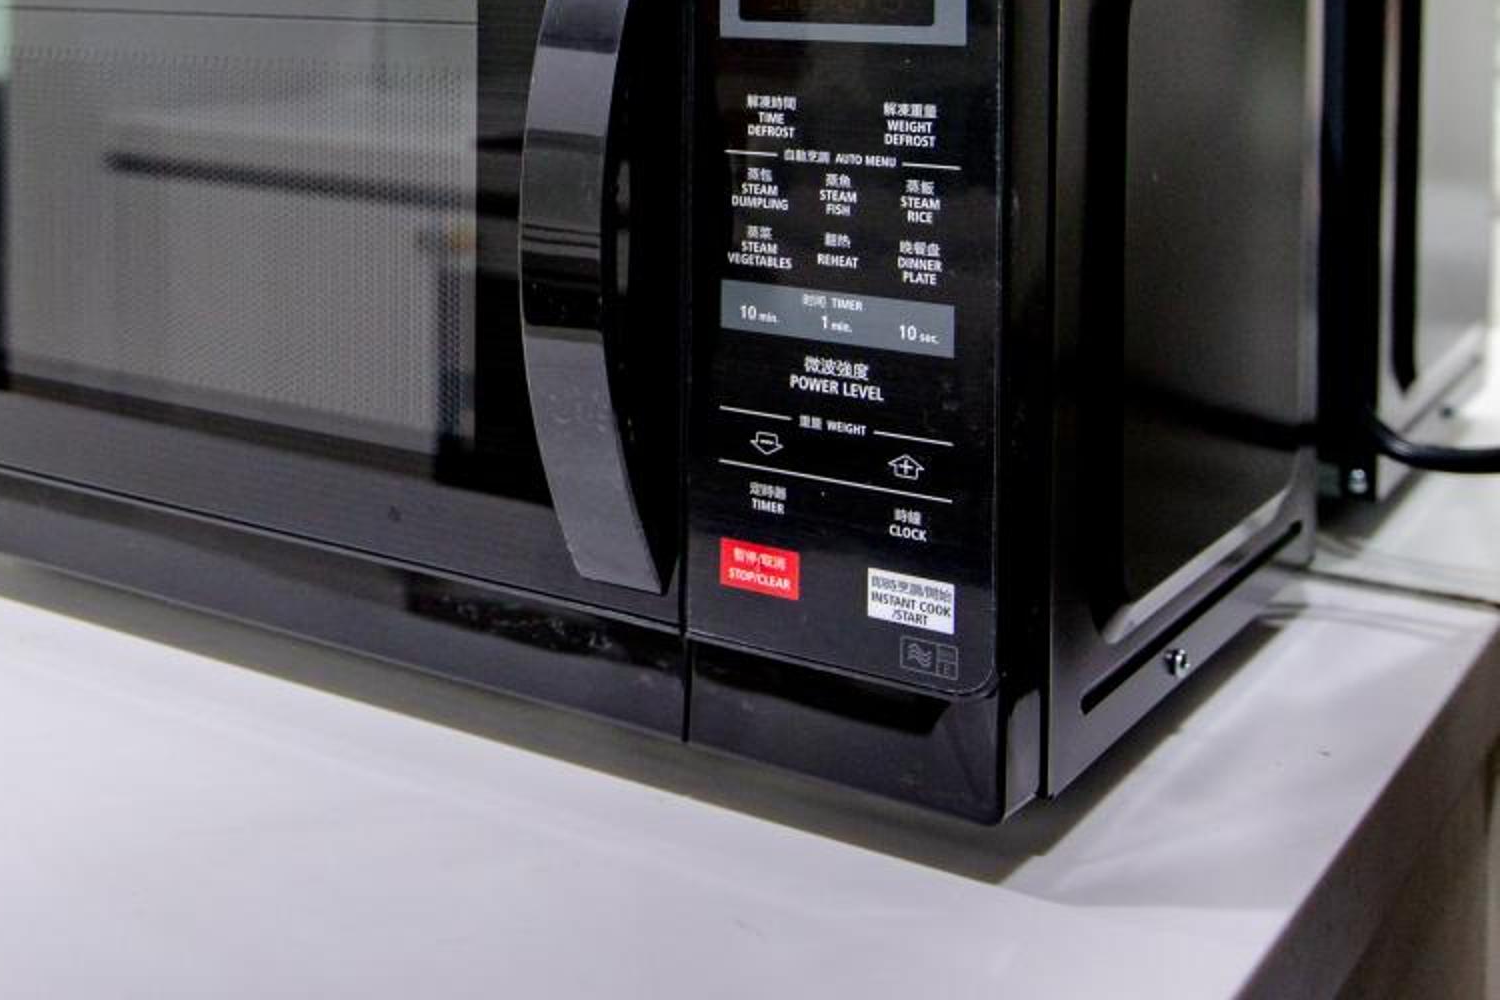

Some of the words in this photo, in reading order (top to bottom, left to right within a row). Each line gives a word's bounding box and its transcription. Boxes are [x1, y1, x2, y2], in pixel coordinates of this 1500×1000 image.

[758, 111, 785, 124] TIME
[747, 123, 795, 138] DEFROST
[887, 119, 933, 133] WEIGHT
[884, 133, 936, 147] DEFROST
[836, 153, 862, 165] AUTO
[865, 155, 897, 168] MENU
[741, 182, 779, 196] STEAM
[820, 189, 857, 203] STEAM
[731, 195, 789, 211] DUMPLING
[826, 203, 851, 216] FISH
[900, 196, 941, 211] STEAM
[907, 210, 933, 224] RICE
[741, 241, 778, 254] STEAM
[727, 251, 792, 269] VEGETABLES
[817, 253, 859, 269] REHEAT
[897, 256, 943, 273] DINNER
[903, 270, 937, 286] PLATE
[832, 298, 863, 311] TIMER
[739, 305, 757, 321] 10
[821, 316, 828, 329] 1
[900, 325, 917, 341] 10
[790, 374, 839, 395] POWER
[843, 382, 884, 401] LEVEL
[827, 420, 867, 436] WEIGHT
[752, 498, 785, 515] TIMER
[889, 524, 927, 542] CLOCK
[728, 567, 791, 590] STOP/CLEAR
[871, 591, 916, 610] INSTANT
[920, 602, 952, 618] COOK
[892, 610, 928, 626] /START
